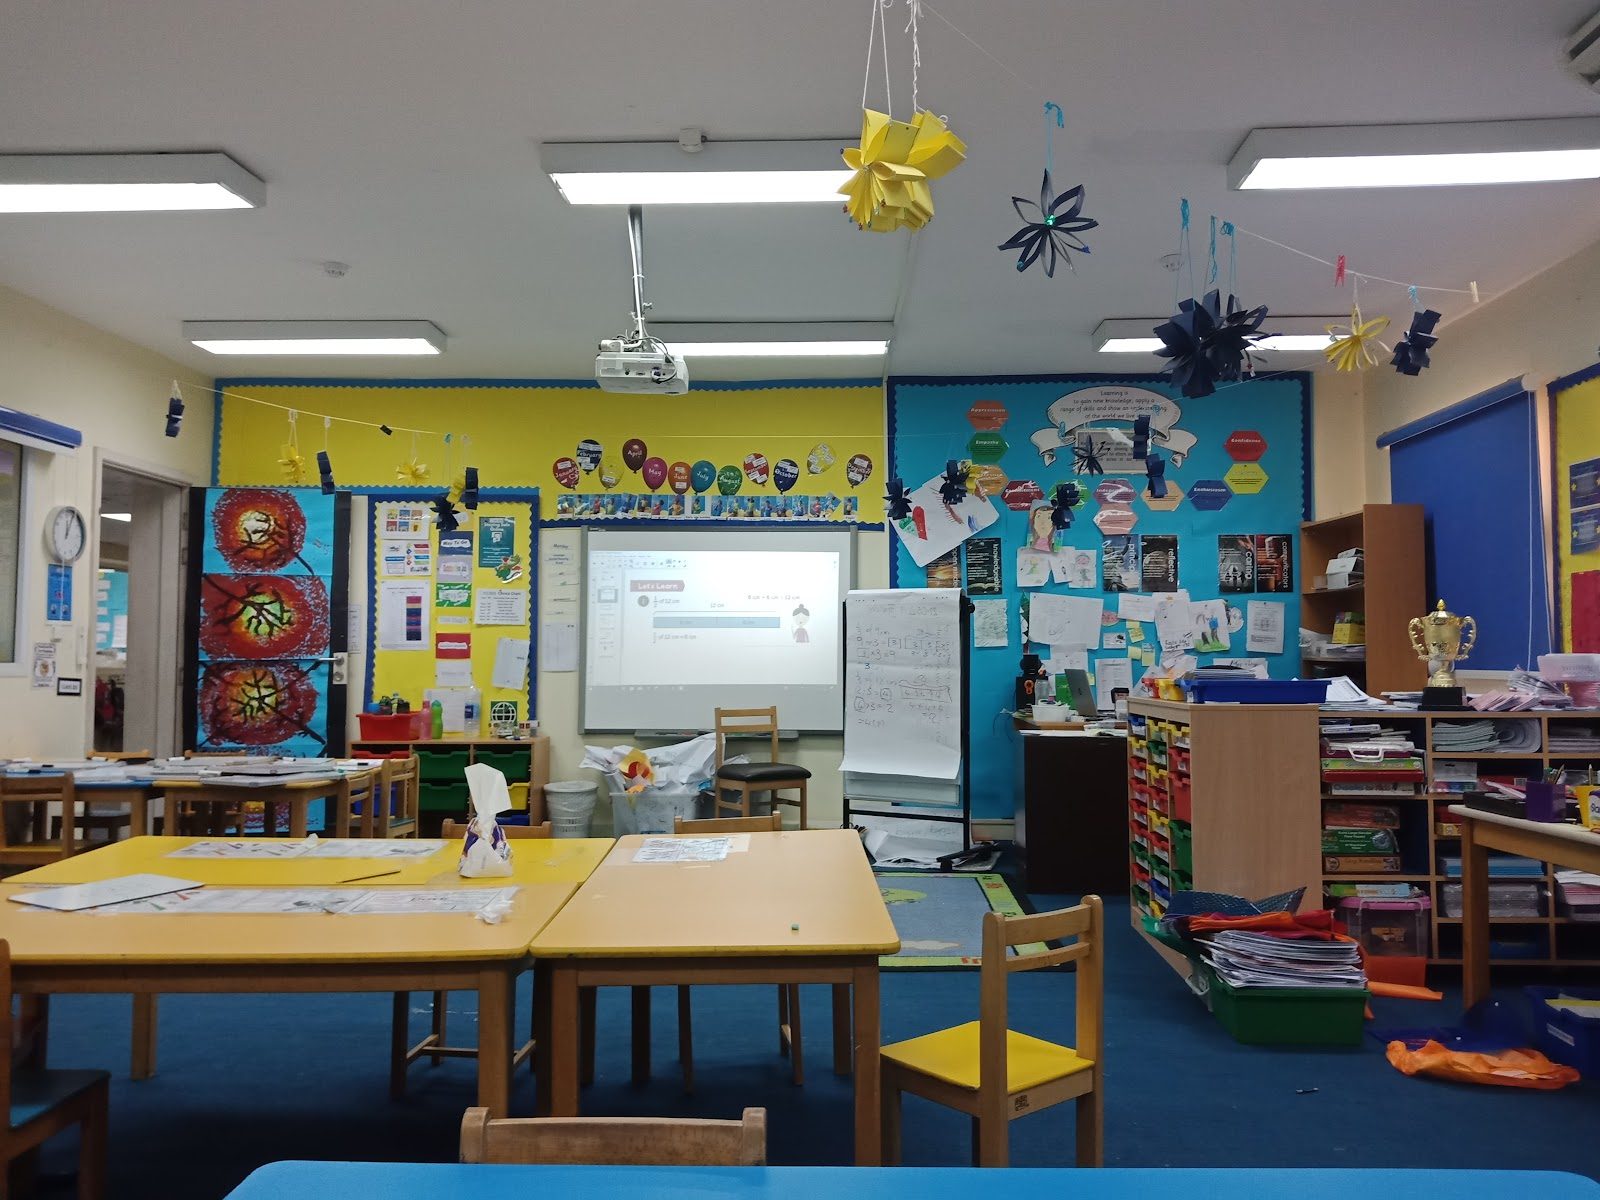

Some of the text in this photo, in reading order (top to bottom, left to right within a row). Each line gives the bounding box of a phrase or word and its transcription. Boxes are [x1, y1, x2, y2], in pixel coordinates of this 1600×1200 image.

[1100, 390, 1123, 398] Learning
[577, 450, 602, 458] February
[627, 449, 642, 457] April
[648, 468, 662, 476] May
[673, 472, 688, 480] June
[696, 471, 709, 481] July
[774, 468, 798, 479] October
[719, 475, 741, 485] August
[992, 543, 1001, 592] knowledgeable
[1168, 548, 1176, 583] reflective
[1244, 551, 1253, 580] caring
[1281, 541, 1290, 589] communicators
[656, 582, 679, 590] Learn
